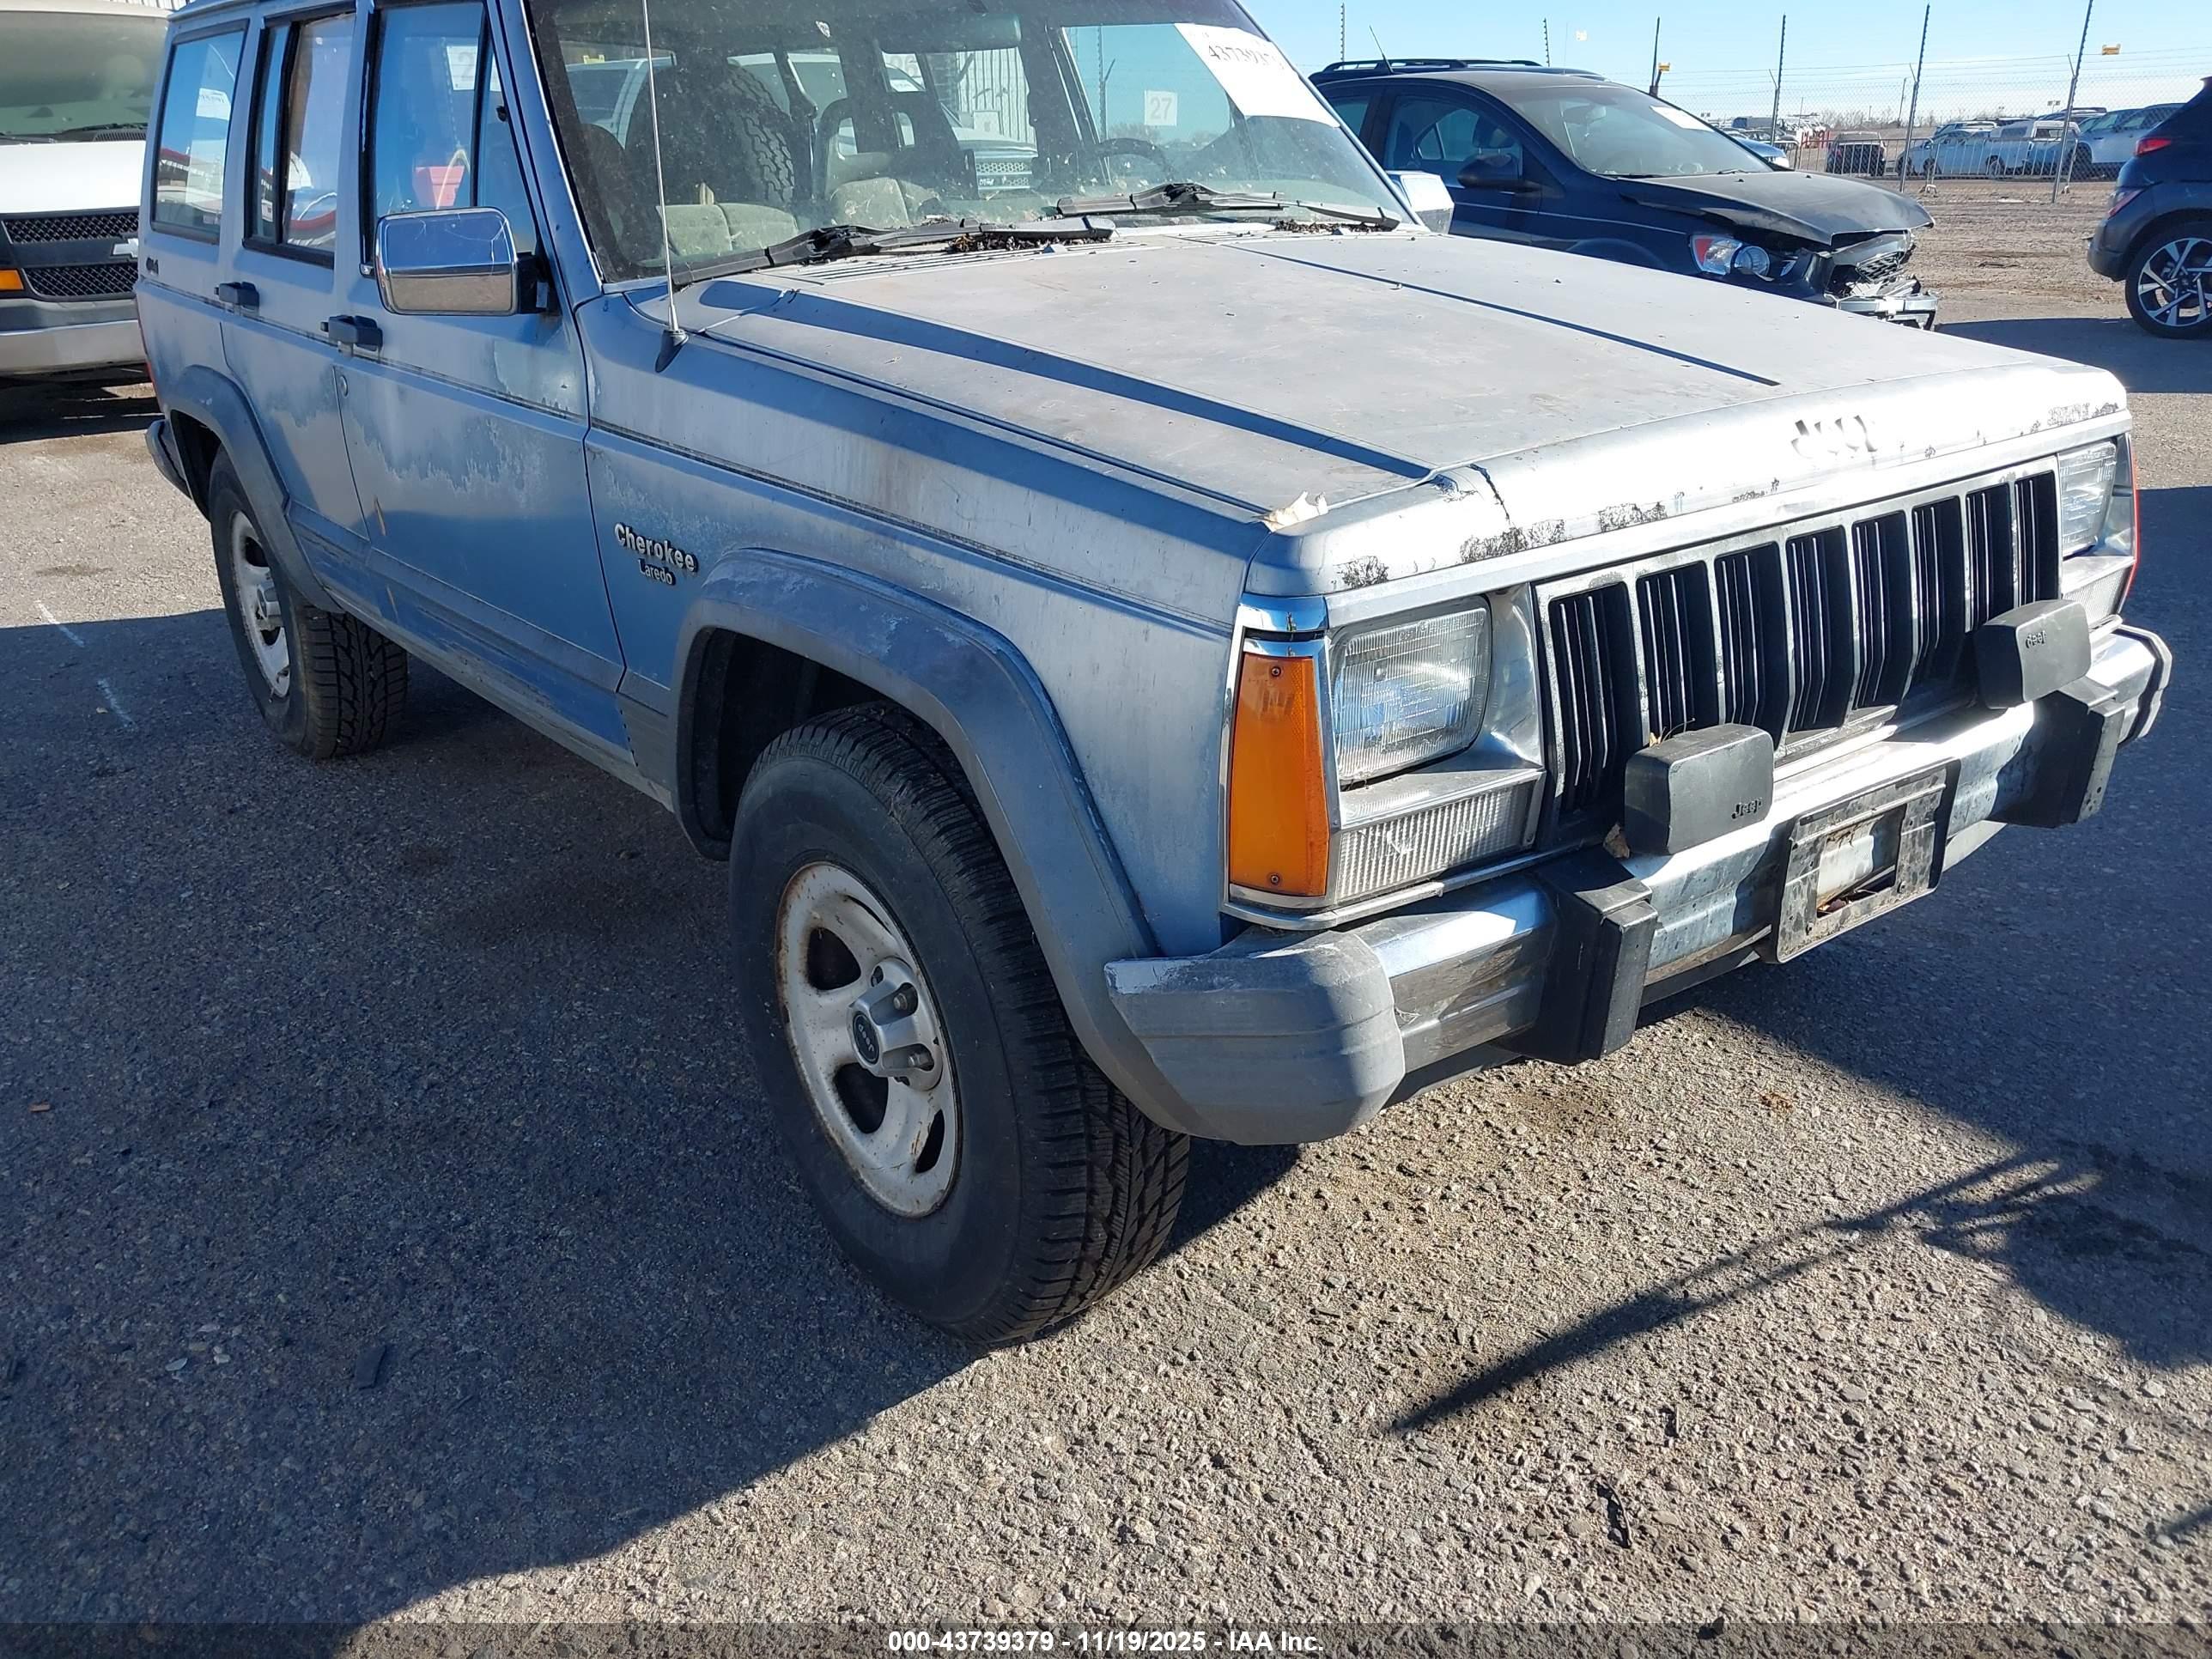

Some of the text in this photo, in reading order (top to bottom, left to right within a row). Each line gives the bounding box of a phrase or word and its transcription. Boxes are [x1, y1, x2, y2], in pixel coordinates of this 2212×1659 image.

[1150, 95, 1172, 120] 27
[614, 522, 697, 573] Cherokee
[637, 558, 675, 585] Laredo
[1731, 798, 1762, 819] Jeep
